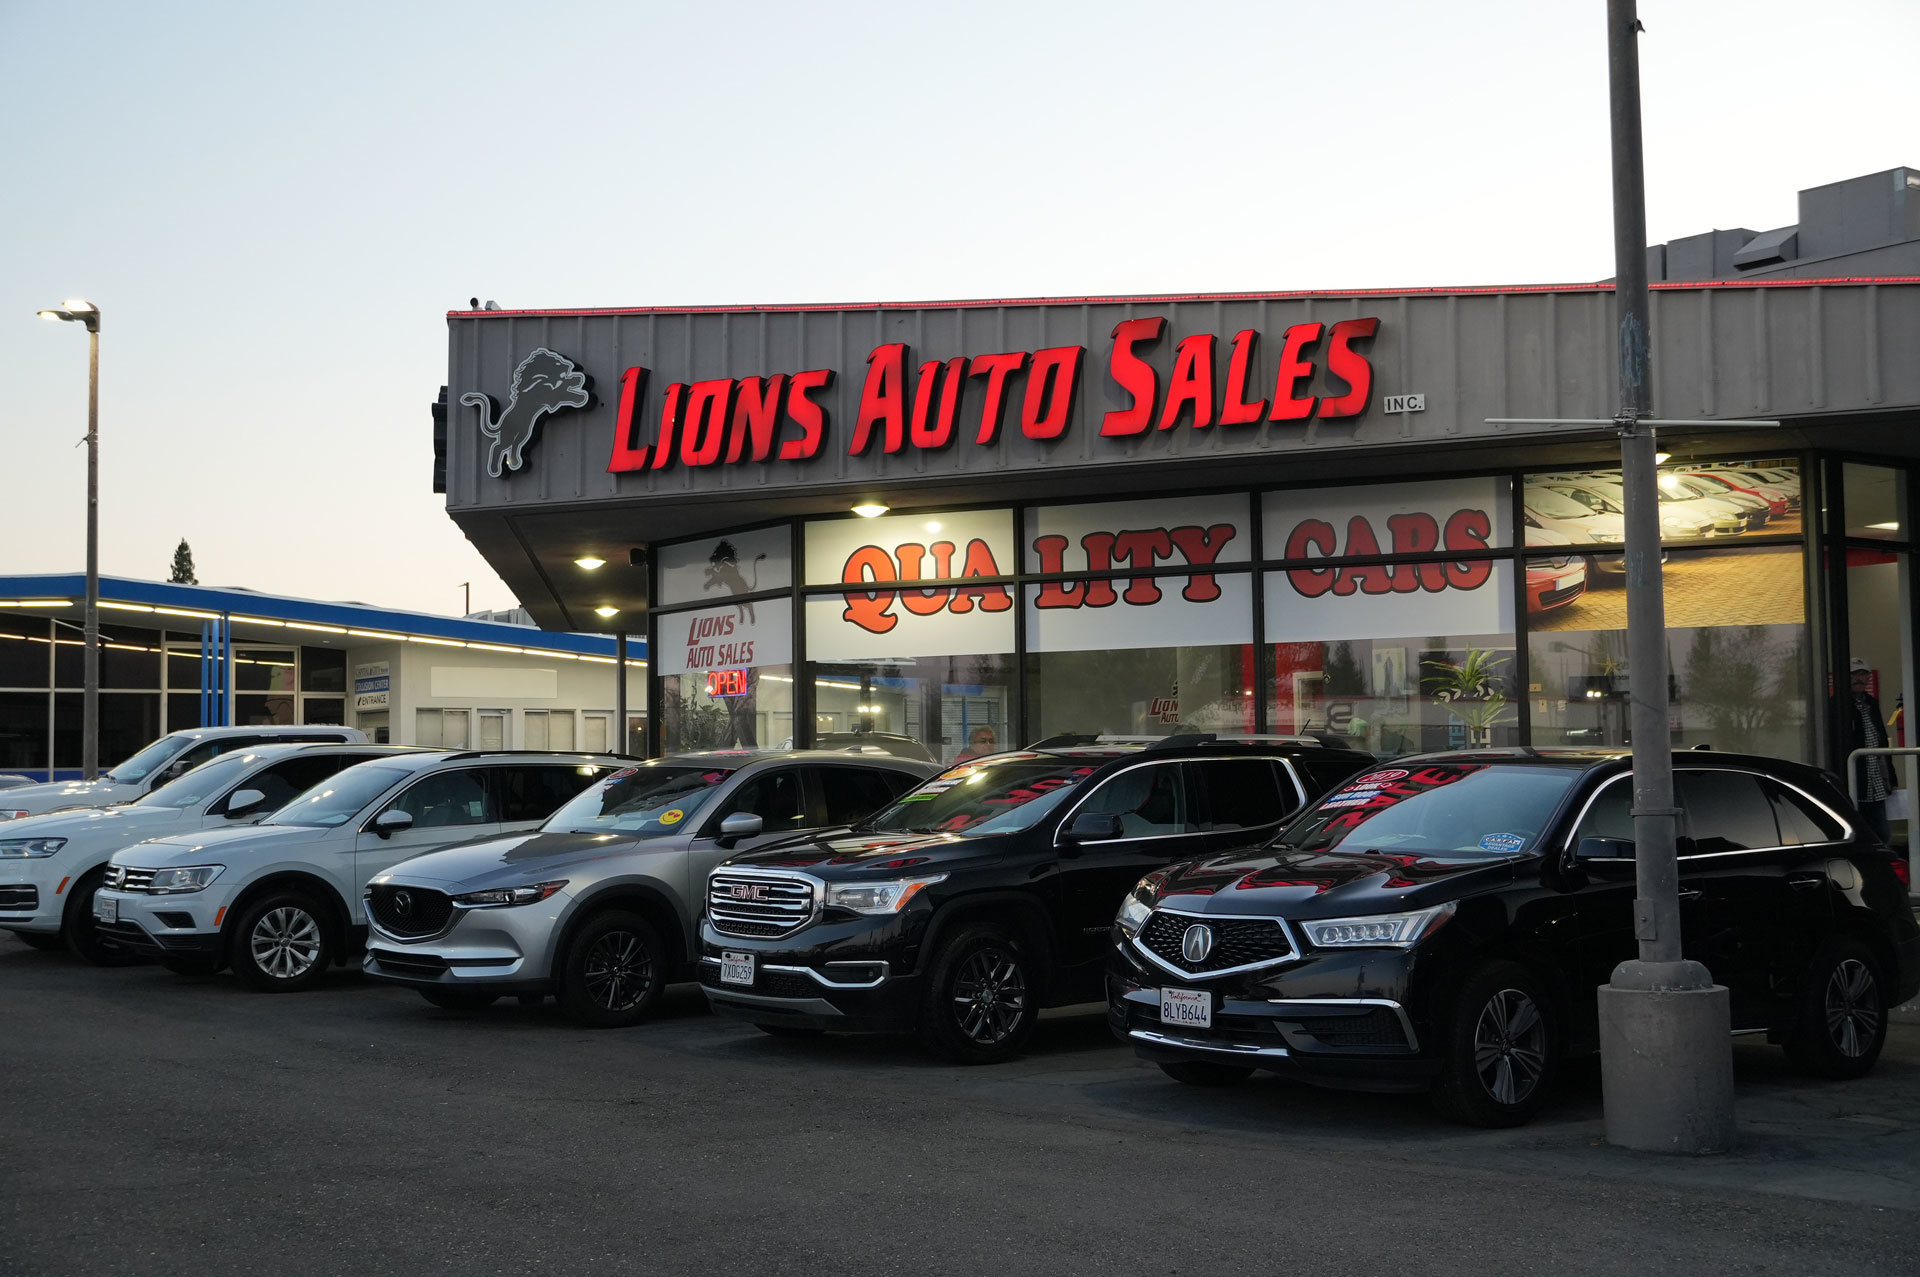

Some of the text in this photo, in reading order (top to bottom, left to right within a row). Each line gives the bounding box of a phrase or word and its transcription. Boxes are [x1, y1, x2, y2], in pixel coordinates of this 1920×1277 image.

[607, 316, 1382, 474] LIONS AUTO SALES
[1387, 396, 1422, 411] INC.
[1284, 508, 1494, 598] CARS
[686, 614, 735, 647] LIONS
[686, 640, 754, 669] AUTO SALES
[708, 670, 747, 695] OPEN
[362, 694, 387, 706] ENTRANCE
[1149, 698, 1179, 716] LION
[730, 885, 770, 901] GMC
[1163, 1001, 1207, 1023] 8LYB644
